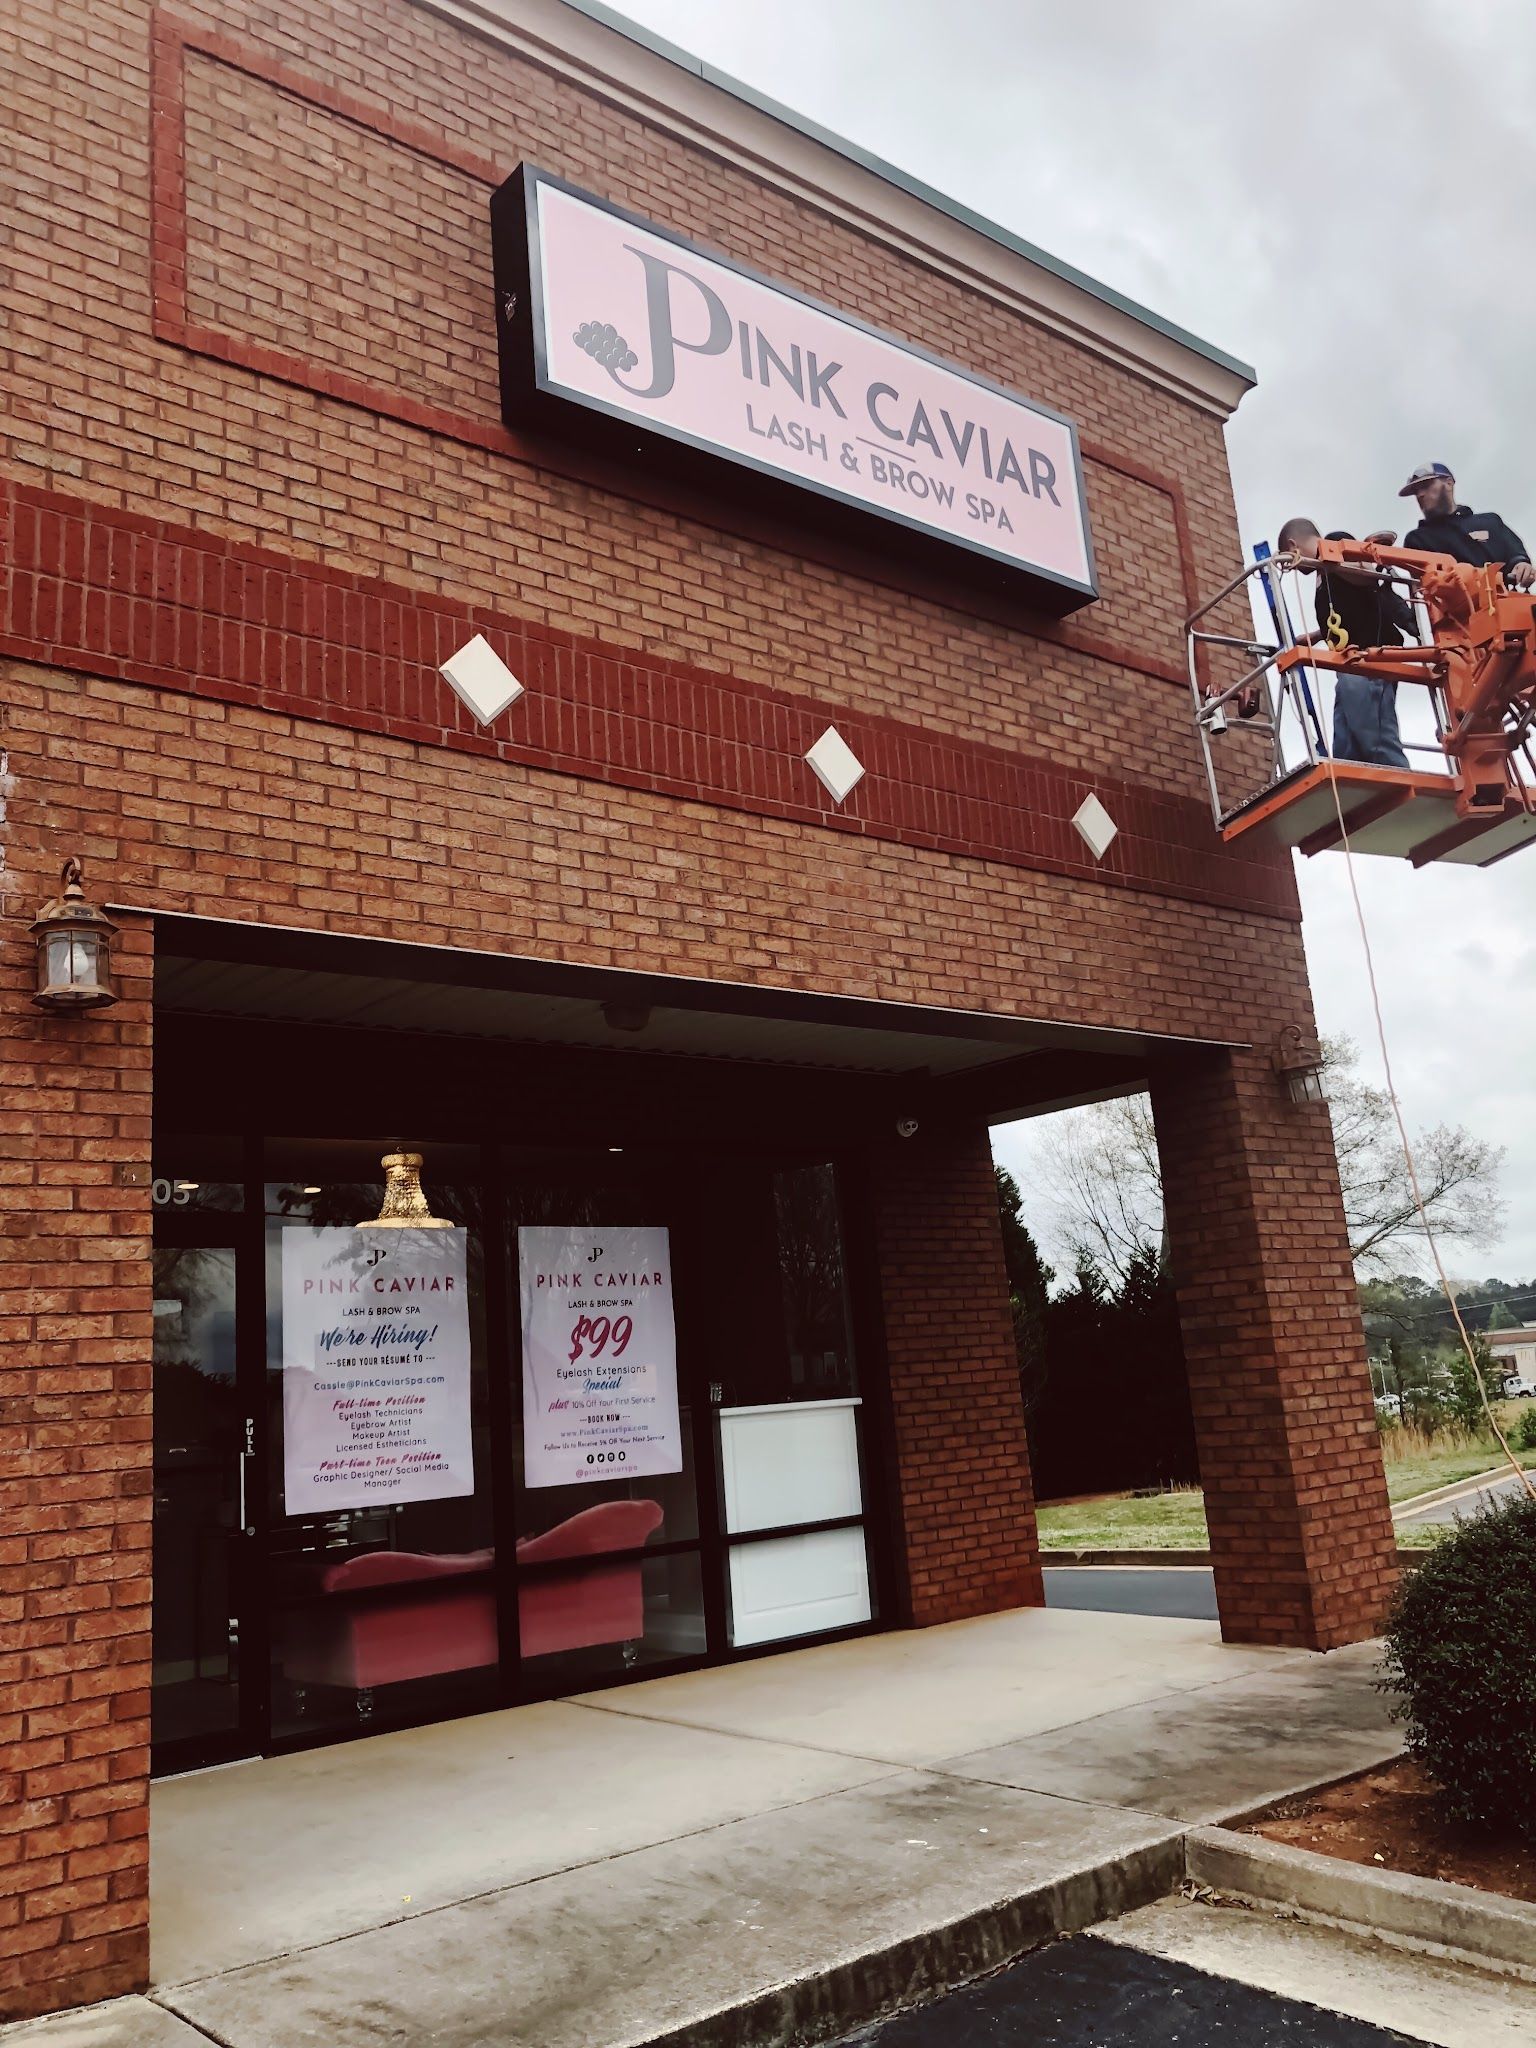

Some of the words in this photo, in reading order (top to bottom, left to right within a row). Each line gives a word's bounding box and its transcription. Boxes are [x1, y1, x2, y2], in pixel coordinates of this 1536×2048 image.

[866, 381, 1062, 507] CAVIAR
[746, 403, 829, 461] LASH
[839, 441, 862, 474] &
[870, 454, 956, 509] BROW
[966, 493, 1015, 535] SPA
[303, 1279, 360, 1295] PINK
[373, 1276, 456, 1293] CAVIAR
[537, 1273, 582, 1288] PINK
[594, 1272, 663, 1287] CAVIAR
[568, 1300, 587, 1309] LASH
[589, 1299, 595, 1308] &
[597, 1299, 618, 1308] BROW
[621, 1299, 633, 1307] SPA
[342, 1307, 365, 1317] LASH
[368, 1307, 374, 1316] &
[376, 1306, 402, 1316] BROW
[405, 1306, 421, 1315] SPA
[320, 1326, 367, 1351] We're
[370, 1323, 438, 1351] Hiring!
[568, 1314, 633, 1366] $99
[360, 1357, 378, 1366] YOUR
[380, 1354, 410, 1365] RÉSUMÉ
[413, 1354, 423, 1363] TO
[557, 1368, 593, 1380] Eyelash
[596, 1365, 647, 1376] Extensions
[314, 1376, 445, 1391] Cassie@PinkCaviarSpa.com
[385, 1394, 426, 1407] Position
[586, 1399, 597, 1408] Off
[599, 1398, 613, 1407] Your
[615, 1397, 629, 1406] First
[631, 1396, 656, 1405] Service
[338, 1410, 372, 1421] Eyelash
[375, 1407, 423, 1418] Technicians
[606, 1413, 620, 1422] NOW
[351, 1421, 386, 1431] Eyebrow
[389, 1418, 412, 1427] Artist
[246, 1418, 254, 1453] PULL
[352, 1431, 385, 1440] Makeup
[388, 1429, 411, 1438] Artist
[336, 1441, 373, 1453] Licensed
[376, 1438, 427, 1449] Estheticians
[577, 1440, 598, 1448] Receive
[401, 1451, 442, 1464] Position
[313, 1472, 348, 1483] Graphic
[396, 1465, 422, 1475] Social
[424, 1462, 449, 1472] Media
[364, 1479, 402, 1488] Manager
